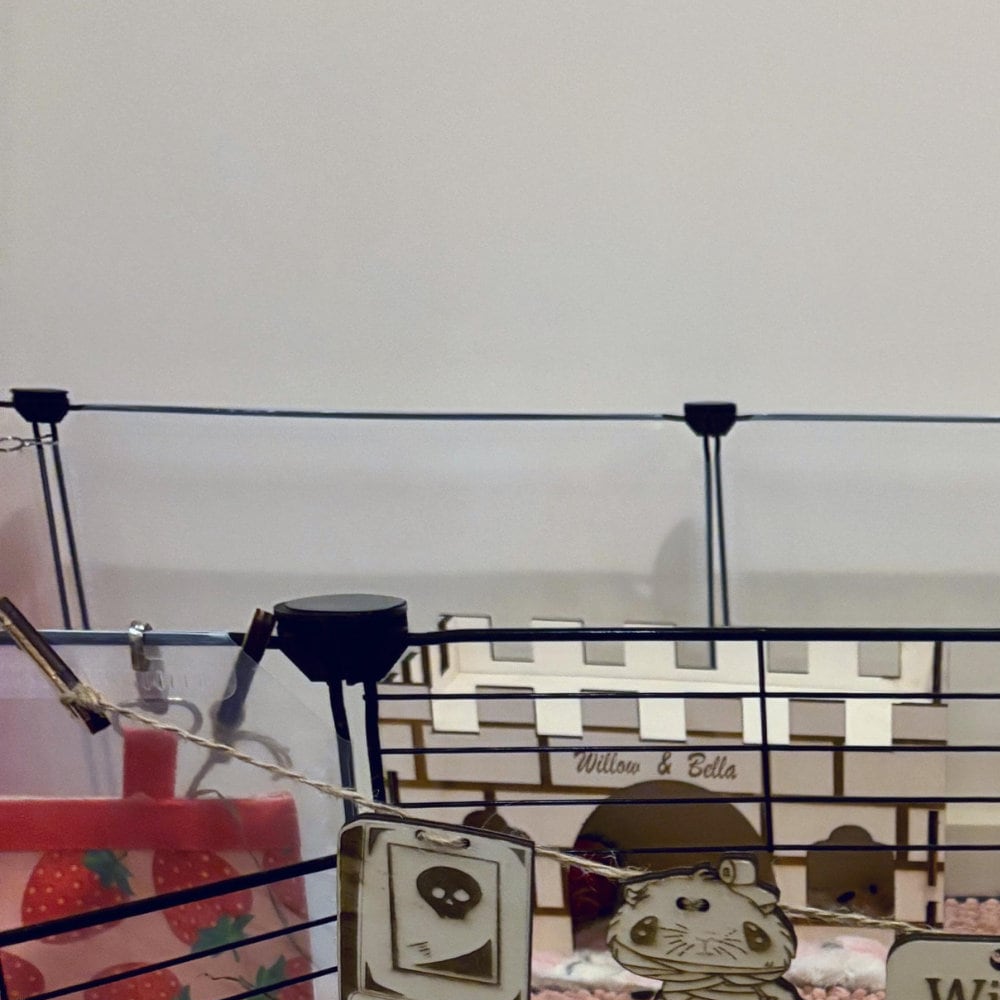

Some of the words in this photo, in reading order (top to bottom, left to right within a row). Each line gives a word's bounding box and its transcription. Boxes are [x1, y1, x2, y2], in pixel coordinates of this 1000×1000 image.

[573, 751, 640, 776] Willow
[656, 752, 672, 776] &
[687, 752, 739, 780] Bella
